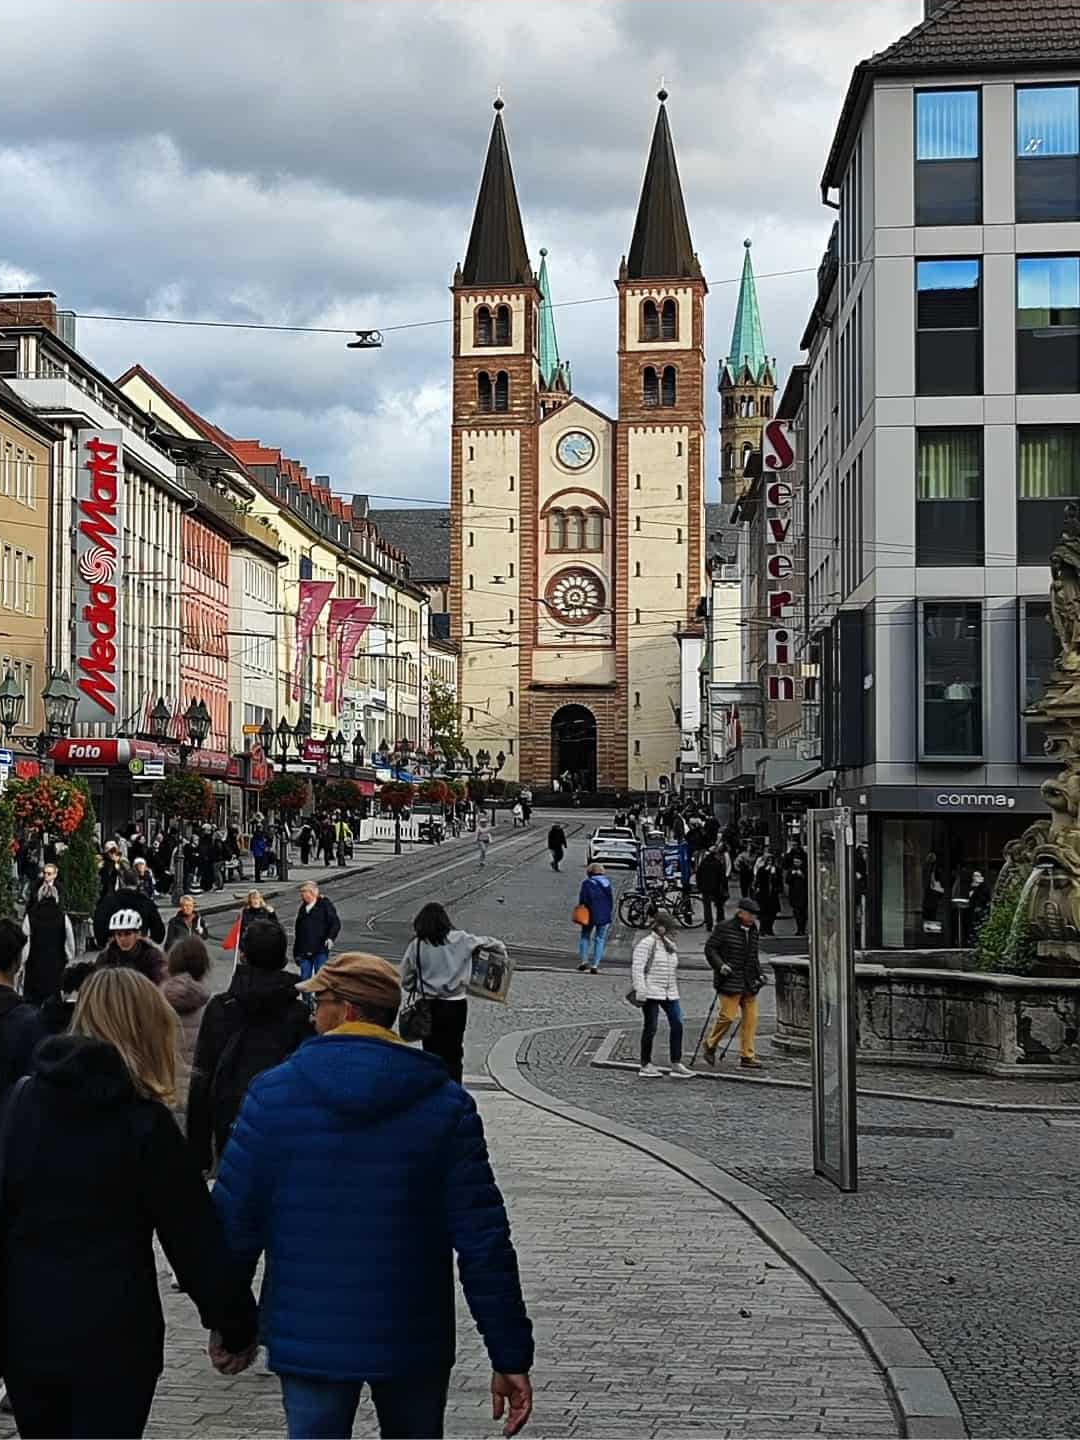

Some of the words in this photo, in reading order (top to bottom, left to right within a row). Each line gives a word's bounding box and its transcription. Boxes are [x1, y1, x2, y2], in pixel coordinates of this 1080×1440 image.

[79, 437, 119, 558] Markt
[764, 419, 795, 700] Severin
[78, 583, 118, 714] Media
[68, 744, 101, 758] Foto
